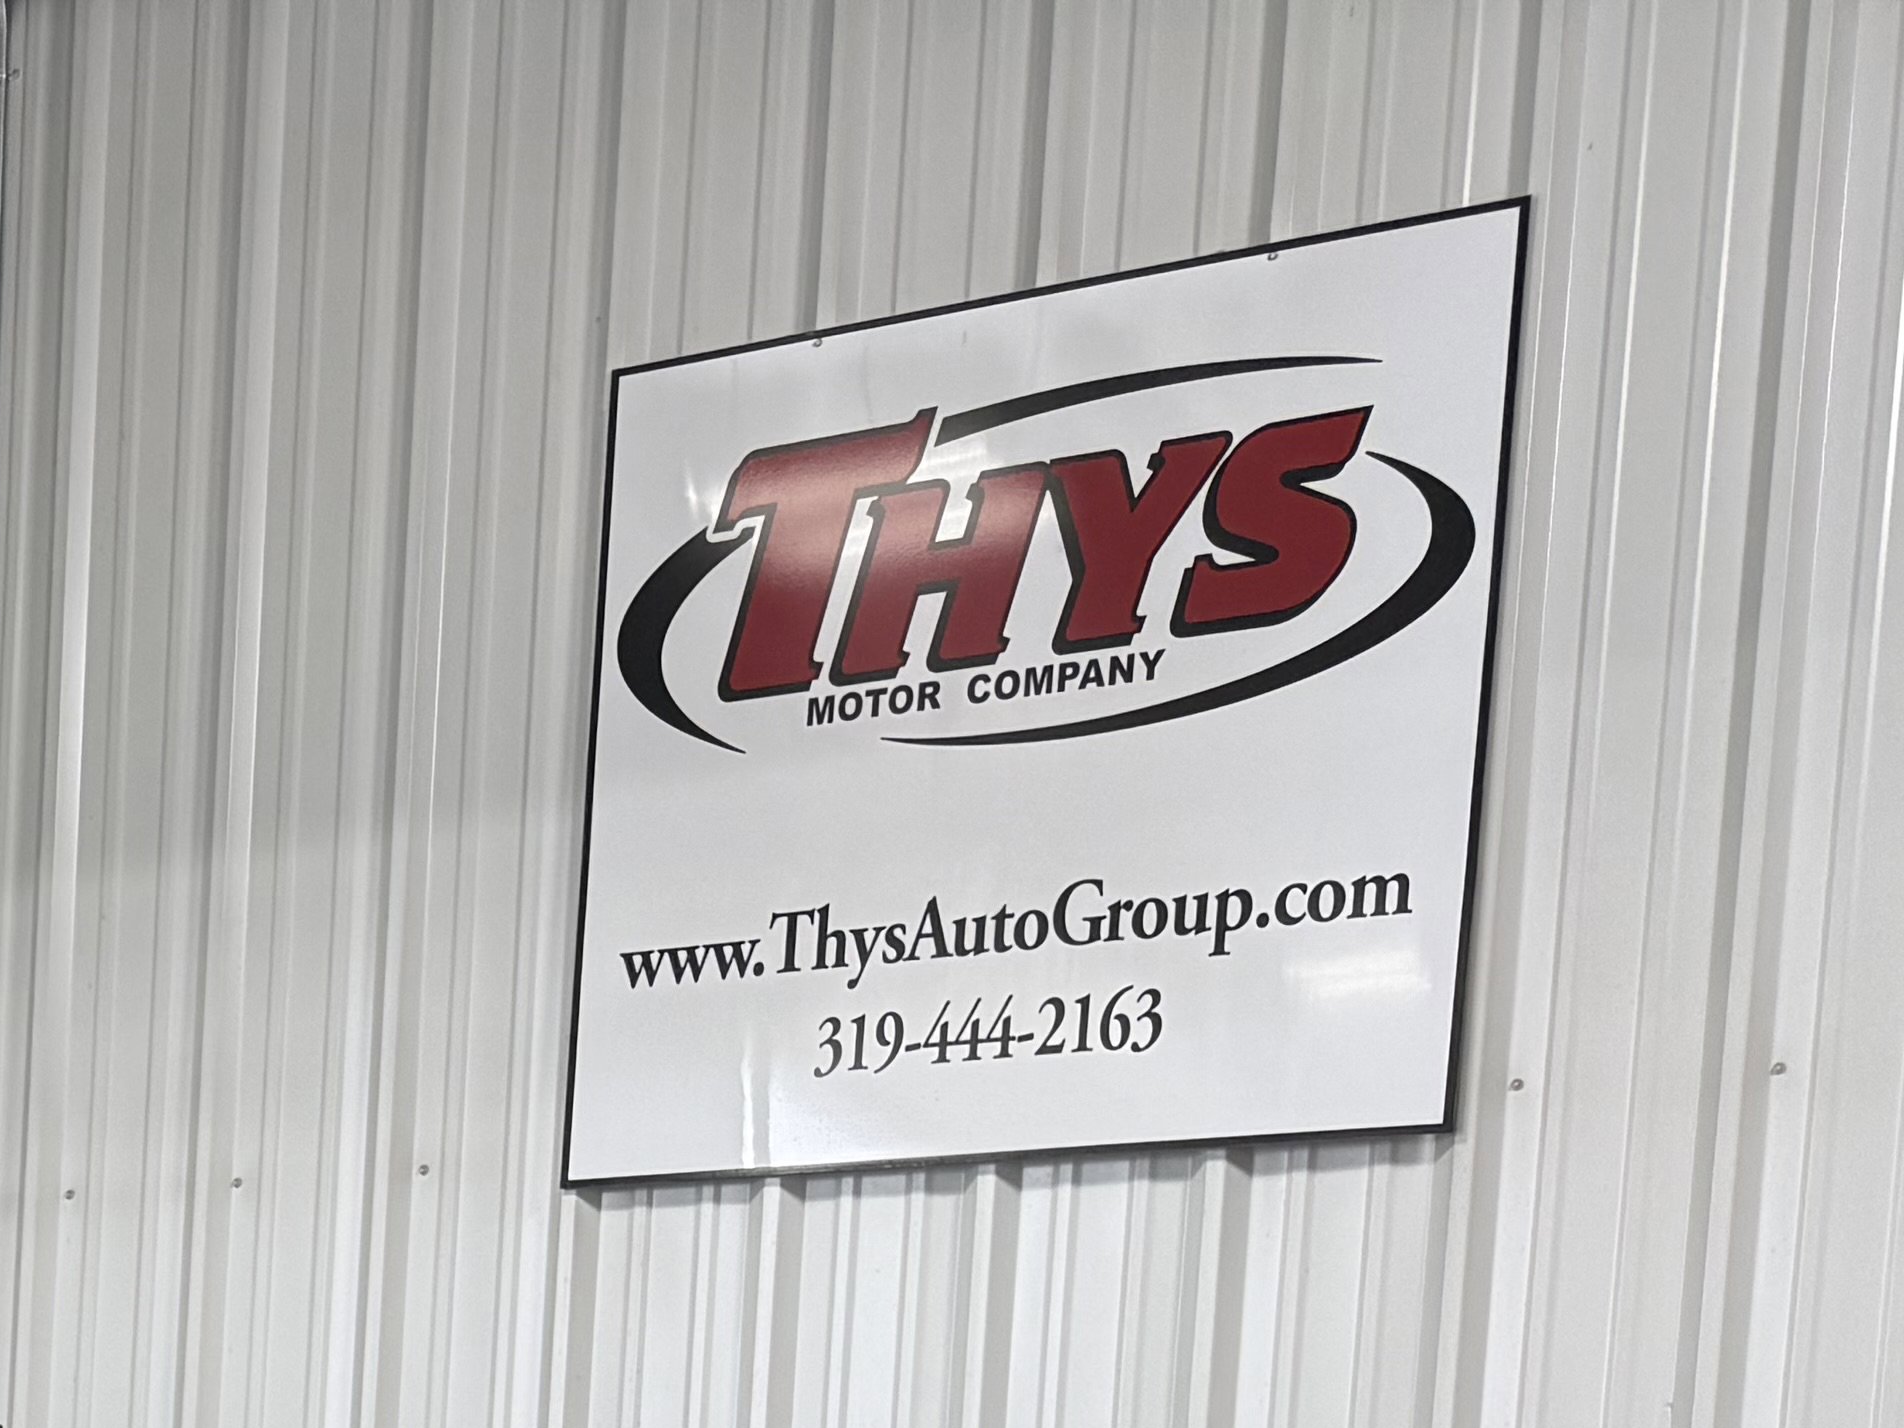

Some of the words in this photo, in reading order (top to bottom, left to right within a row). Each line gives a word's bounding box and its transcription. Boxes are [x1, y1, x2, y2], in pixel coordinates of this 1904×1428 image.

[706, 405, 1375, 703] THYS
[805, 681, 942, 728] MOTOR
[966, 648, 1167, 705] COMPANY
[618, 872, 1414, 990] www.ThysAutoGroup.com
[812, 985, 1164, 1078] 319-444-2163
